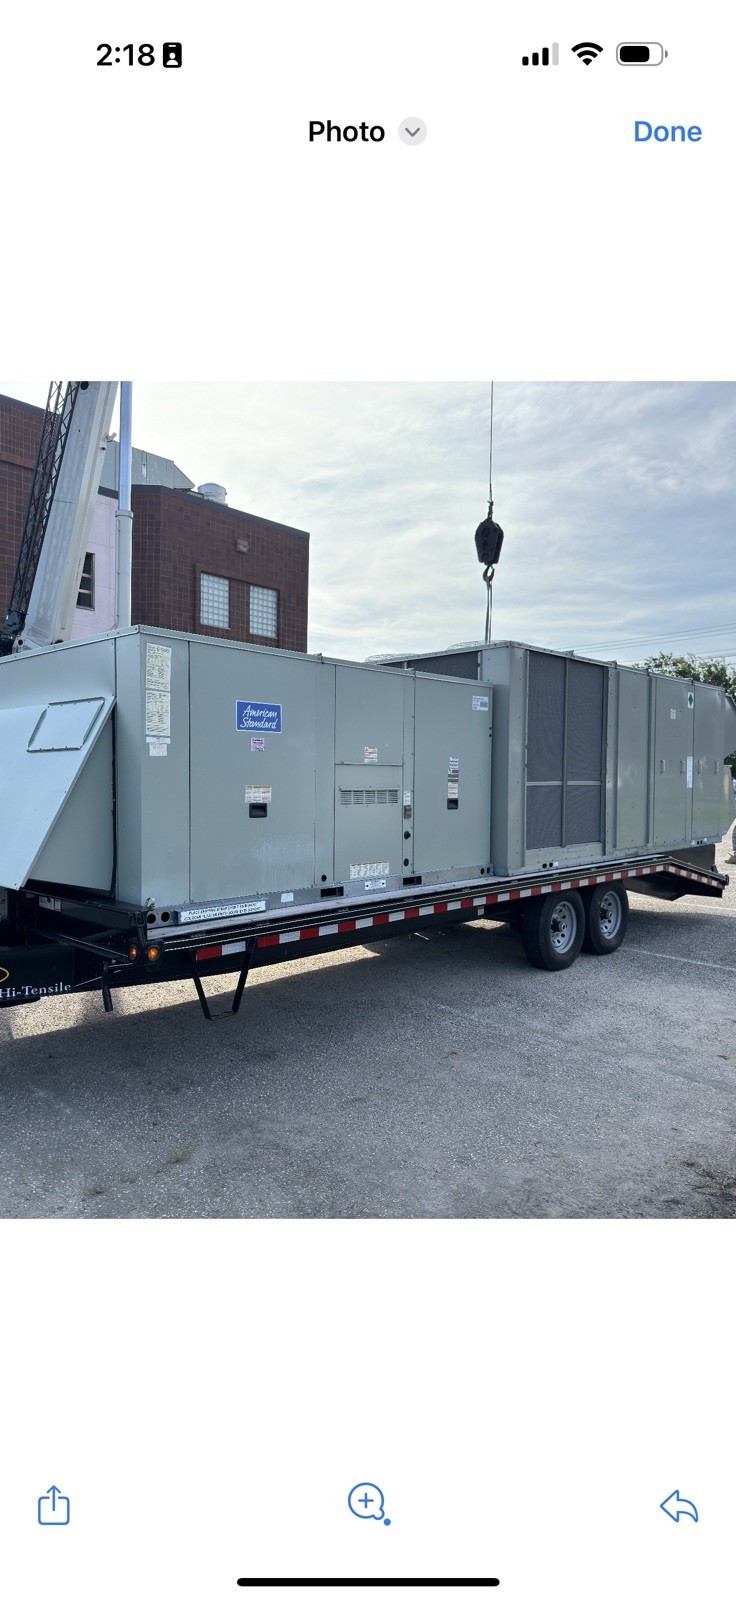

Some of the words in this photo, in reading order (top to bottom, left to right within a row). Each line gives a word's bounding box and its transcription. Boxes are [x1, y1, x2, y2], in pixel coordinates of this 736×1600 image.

[242, 705, 278, 718] American
[240, 717, 278, 729] Standard
[0, 981, 71, 999] Hi-Tensile
